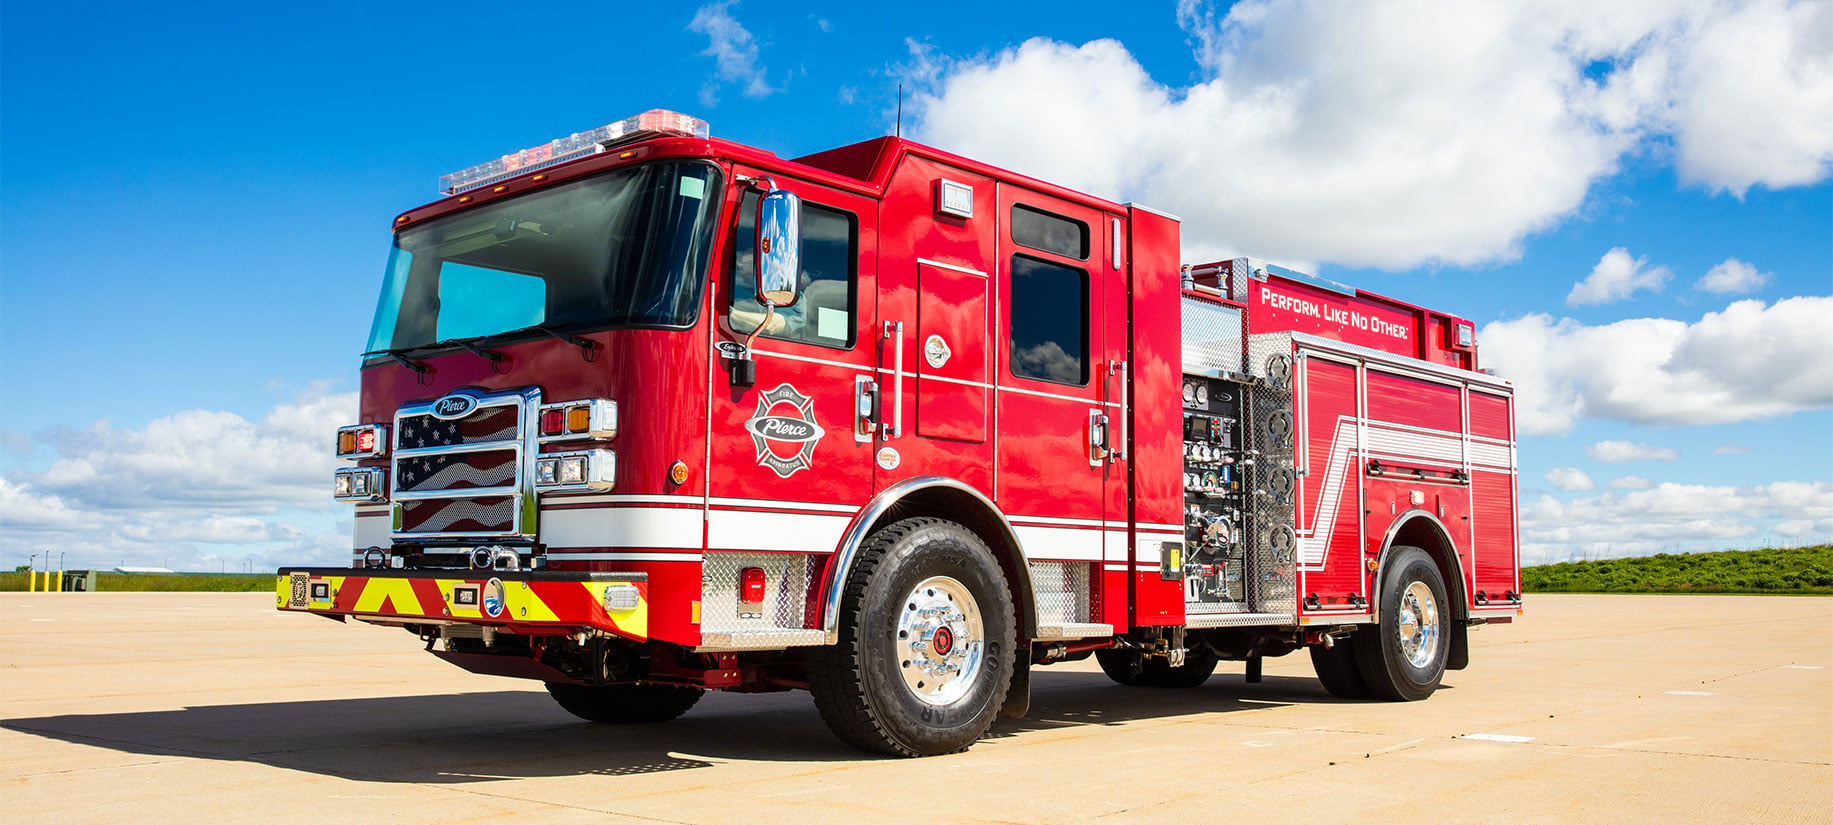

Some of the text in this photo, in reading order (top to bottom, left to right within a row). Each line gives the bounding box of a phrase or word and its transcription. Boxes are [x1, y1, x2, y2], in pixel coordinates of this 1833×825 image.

[1324, 303, 1349, 325] LIKE
[779, 391, 795, 400] FIRE
[439, 399, 466, 415] Pierce
[762, 418, 808, 437] Pierce
